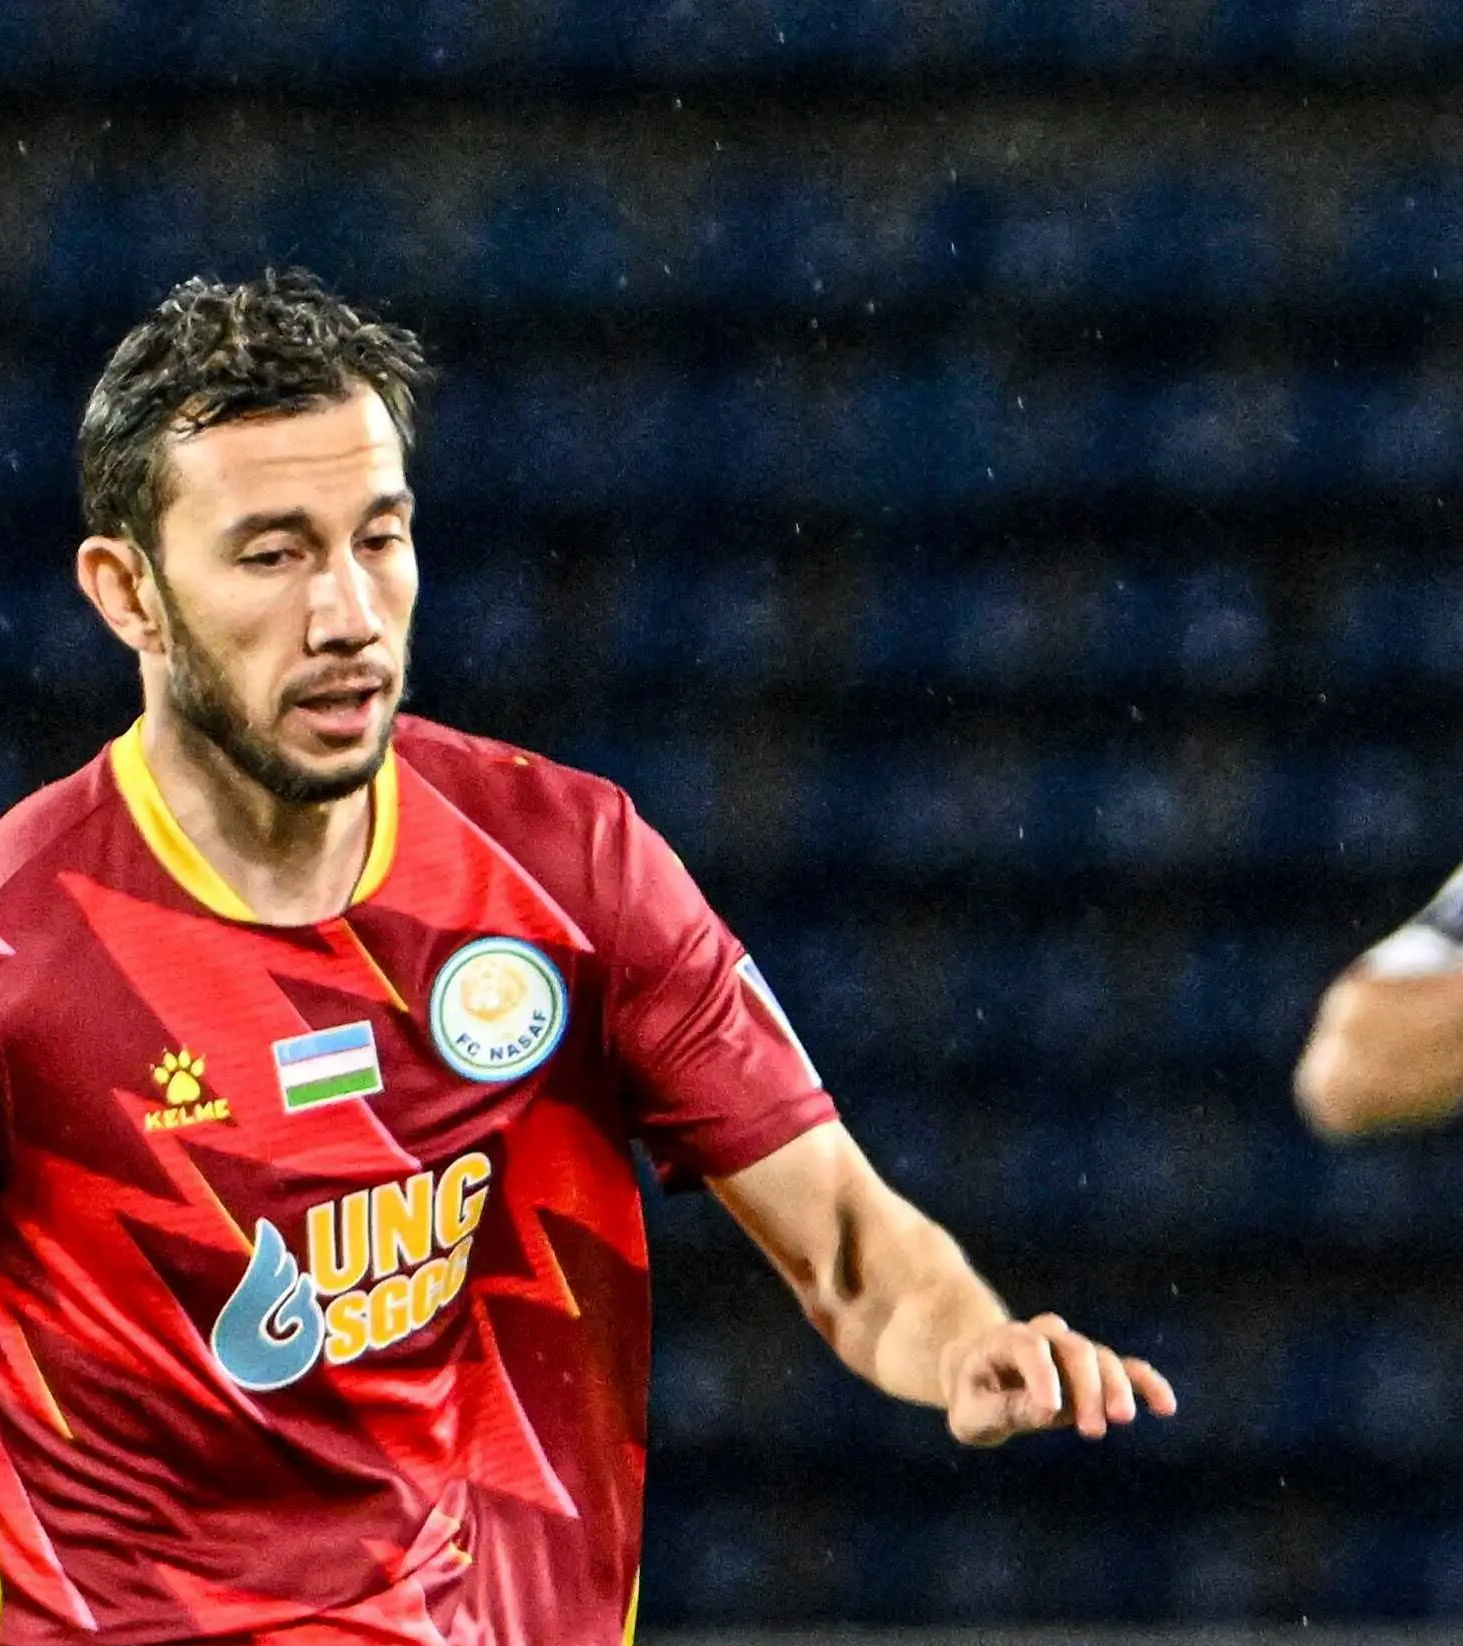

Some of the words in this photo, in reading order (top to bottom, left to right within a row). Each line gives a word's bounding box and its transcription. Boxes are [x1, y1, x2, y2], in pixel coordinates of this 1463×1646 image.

[457, 1032, 481, 1057] FC
[490, 1008, 546, 1061] NASAF
[144, 1097, 231, 1132] KELME
[306, 1152, 492, 1297] UNG
